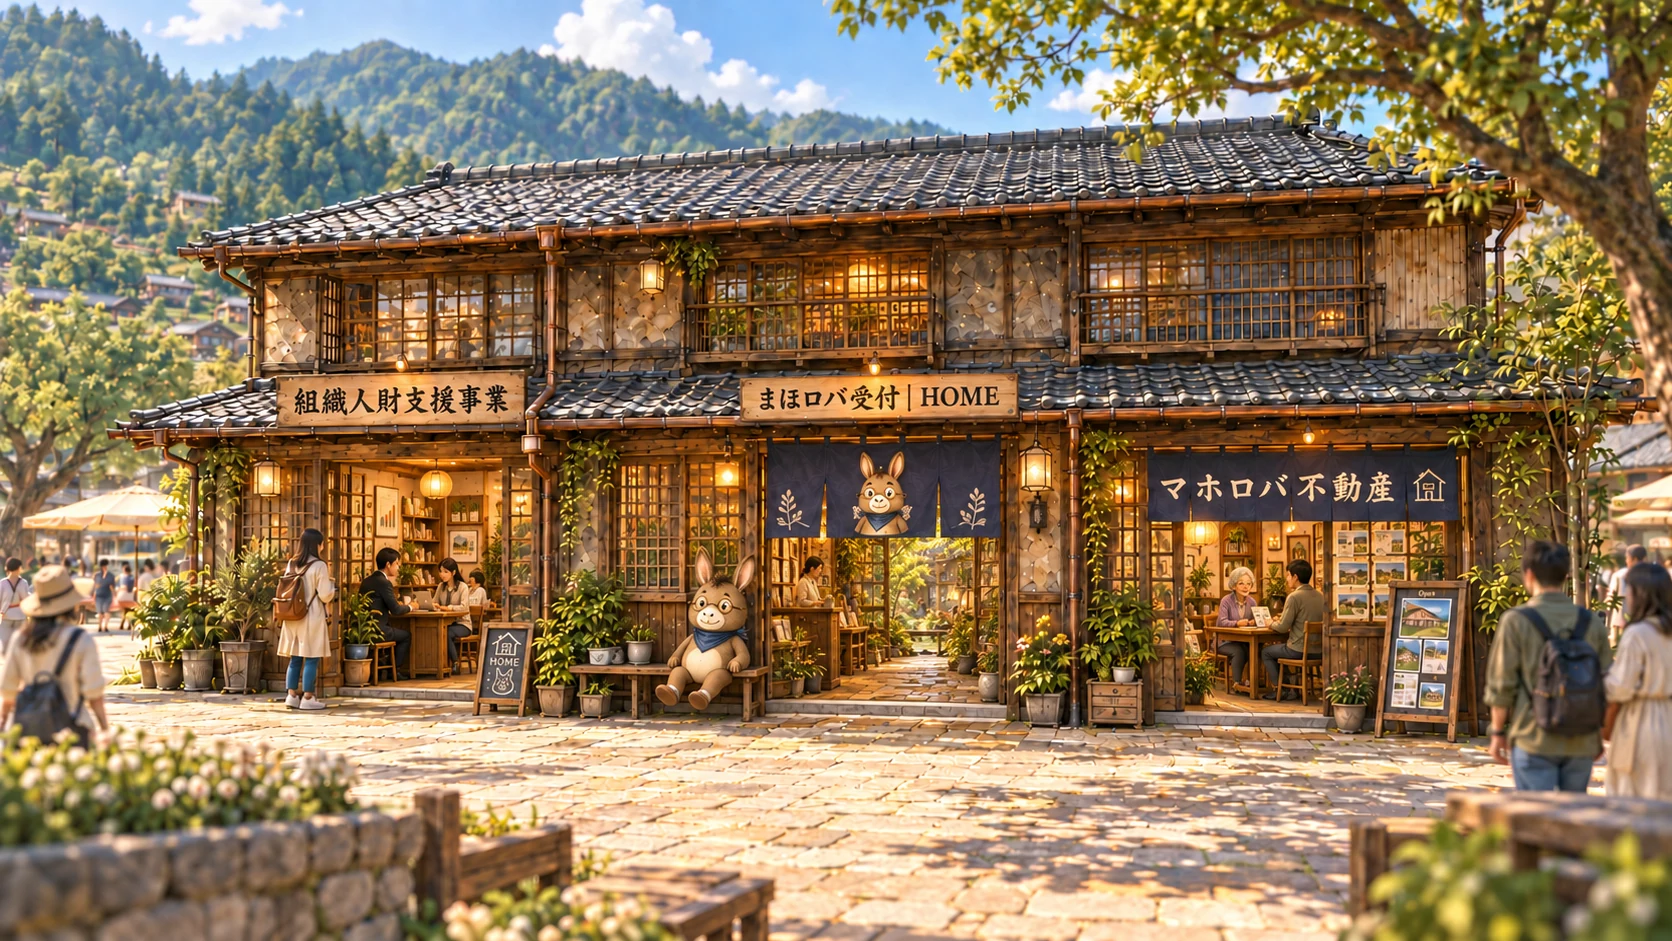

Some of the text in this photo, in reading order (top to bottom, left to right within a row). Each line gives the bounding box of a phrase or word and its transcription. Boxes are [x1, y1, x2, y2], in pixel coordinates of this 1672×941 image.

[294, 384, 509, 415] 組織人財支援事業
[759, 384, 900, 411] まほロバ受付
[920, 386, 1000, 407] HOME
[1160, 471, 1395, 503] マホロバ不動産
[490, 657, 520, 667] HOME
